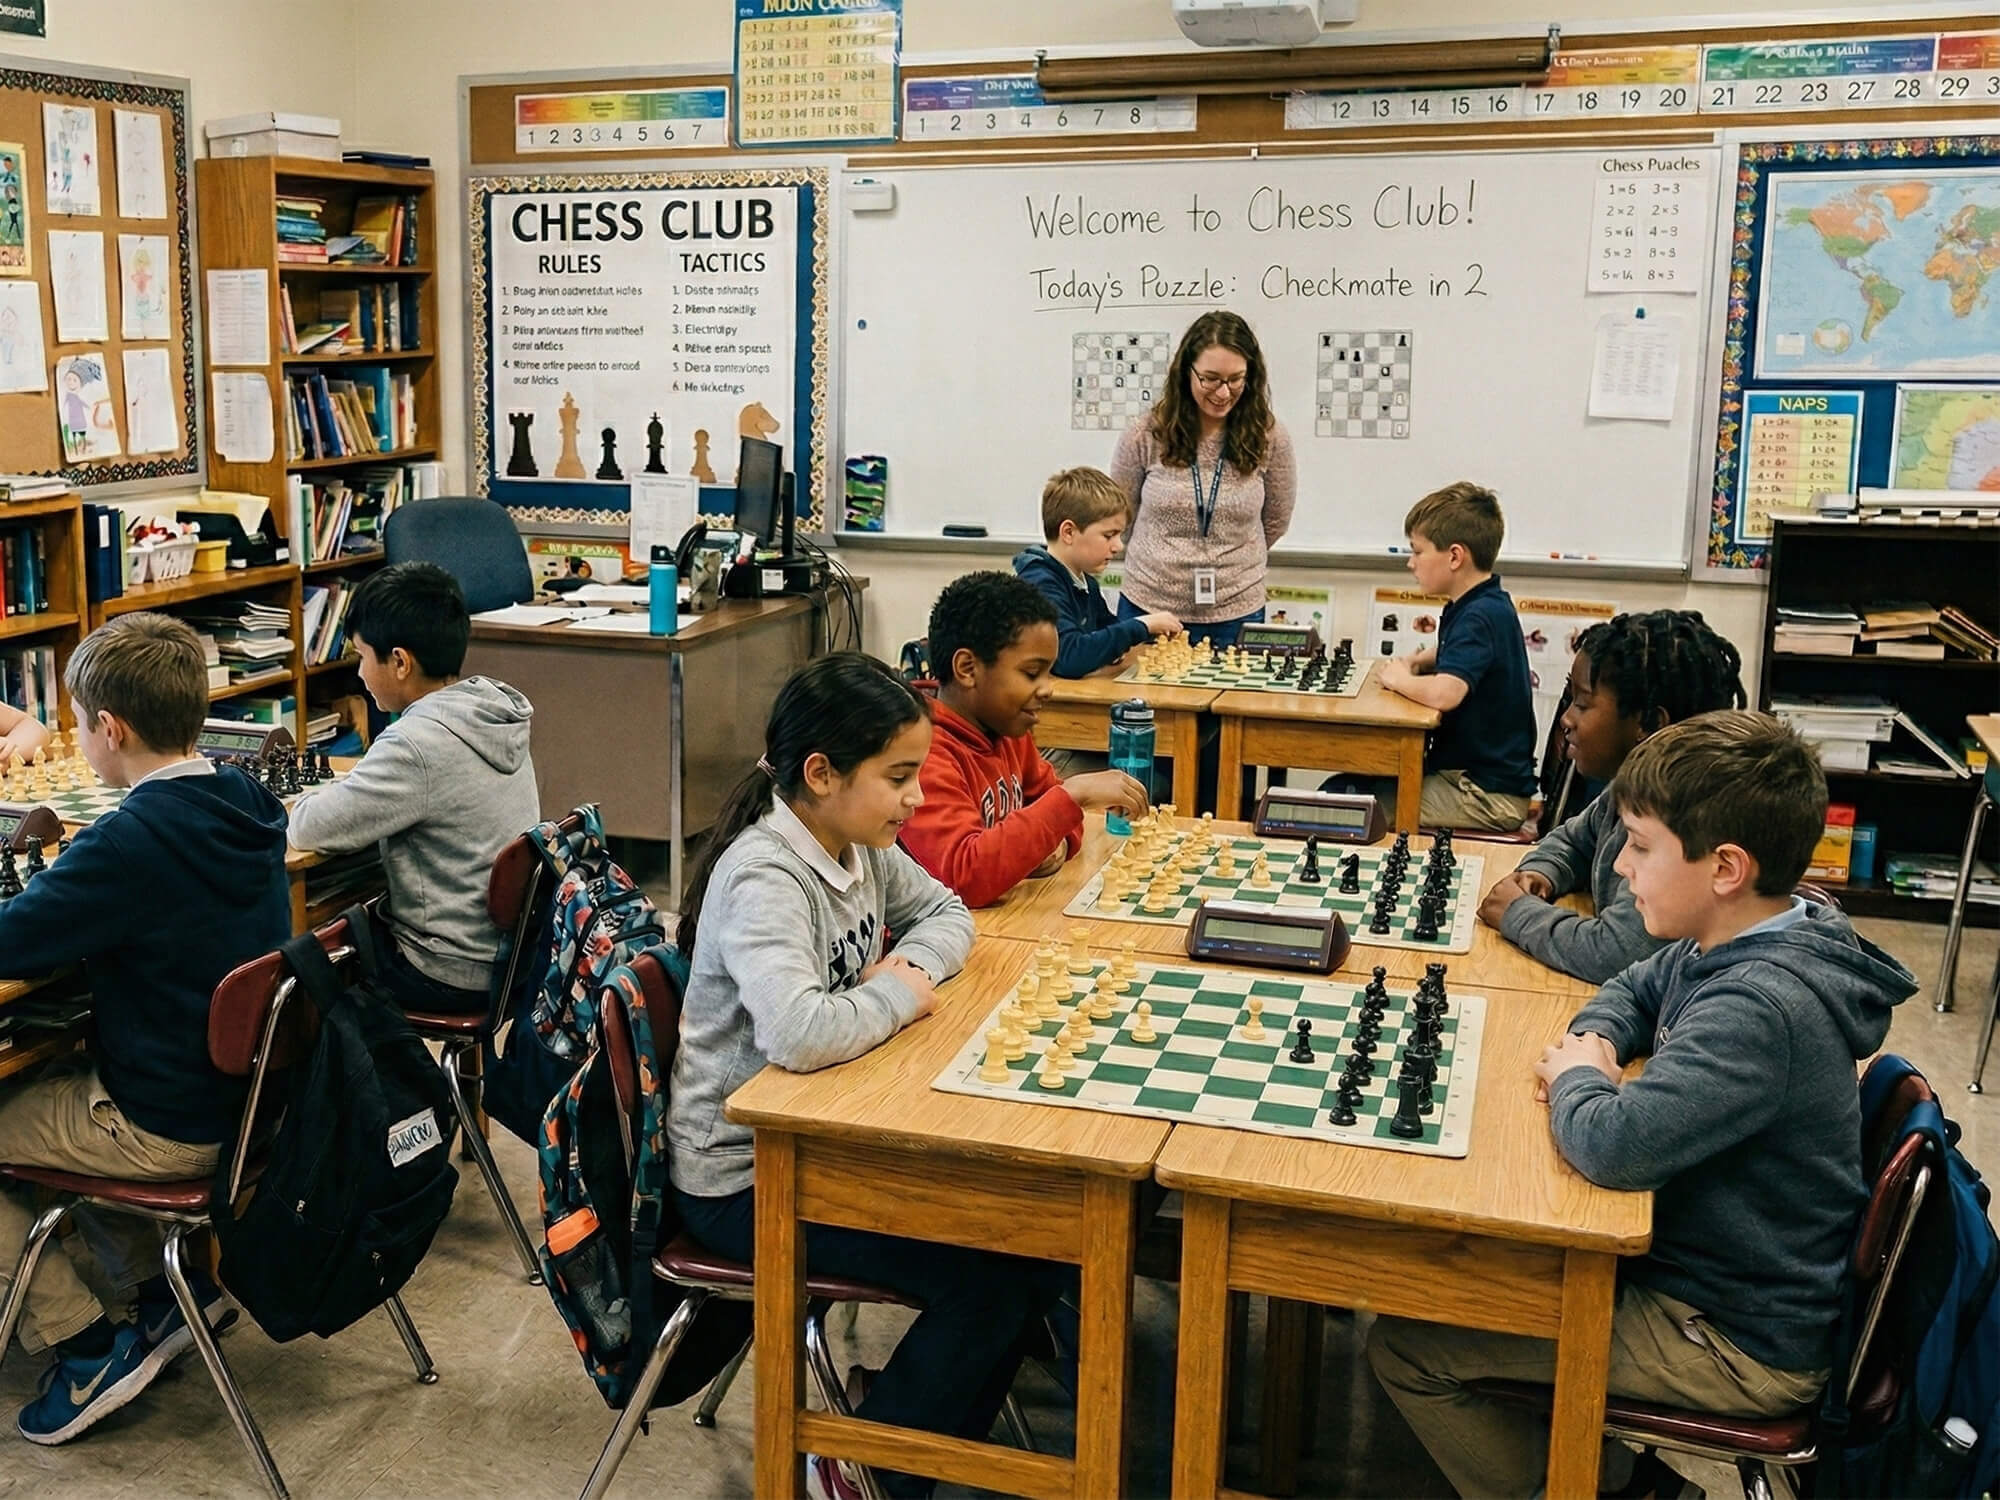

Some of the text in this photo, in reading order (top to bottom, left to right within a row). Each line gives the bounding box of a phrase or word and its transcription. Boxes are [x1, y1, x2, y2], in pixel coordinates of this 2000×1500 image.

[1331, 88, 1686, 119] 12 13 14 15 16 17 18 19 20
[1712, 87, 1734, 106] 21
[1755, 85, 1782, 104] 22
[1800, 83, 1828, 102] 23
[1848, 81, 1875, 100] 27
[1894, 79, 1921, 98] 28
[1941, 77, 1970, 96] 29
[920, 108, 1141, 132] 1 2 3 4 6 7 8
[528, 124, 702, 144] 1 2 3 3 4 5 6 7
[1603, 158, 1644, 172] Chess
[512, 199, 775, 242] CHESS CLUB
[1026, 179, 1476, 239] Welcome to Chess Club!
[538, 254, 602, 274] RULES
[680, 252, 766, 274] TACTICS
[1029, 263, 1488, 313] Today's Puzzle: Checkmate in 2
[1779, 397, 1828, 411] NAPS
